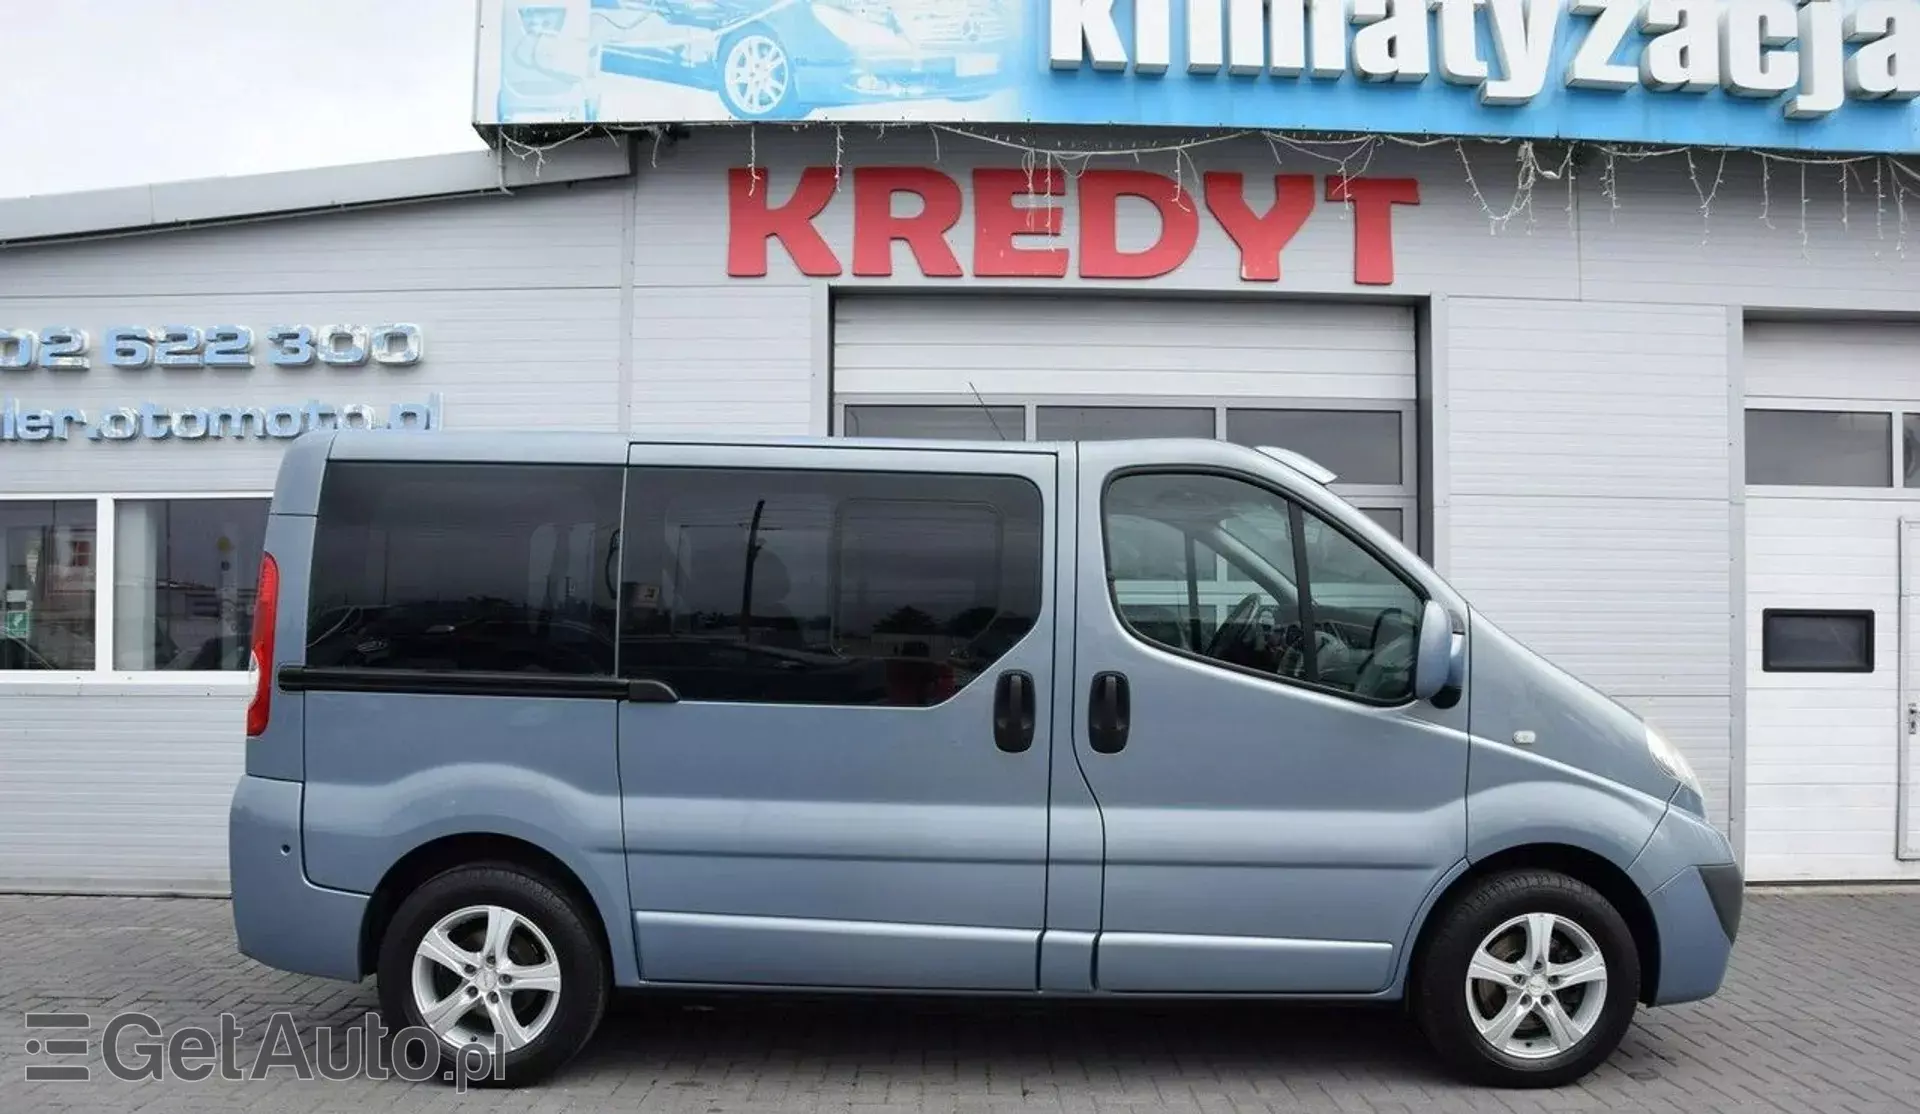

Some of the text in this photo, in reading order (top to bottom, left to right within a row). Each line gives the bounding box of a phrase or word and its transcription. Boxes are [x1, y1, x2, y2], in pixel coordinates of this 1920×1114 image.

[727, 166, 1420, 285] KREDYT
[0, 322, 423, 371] 02 622 300
